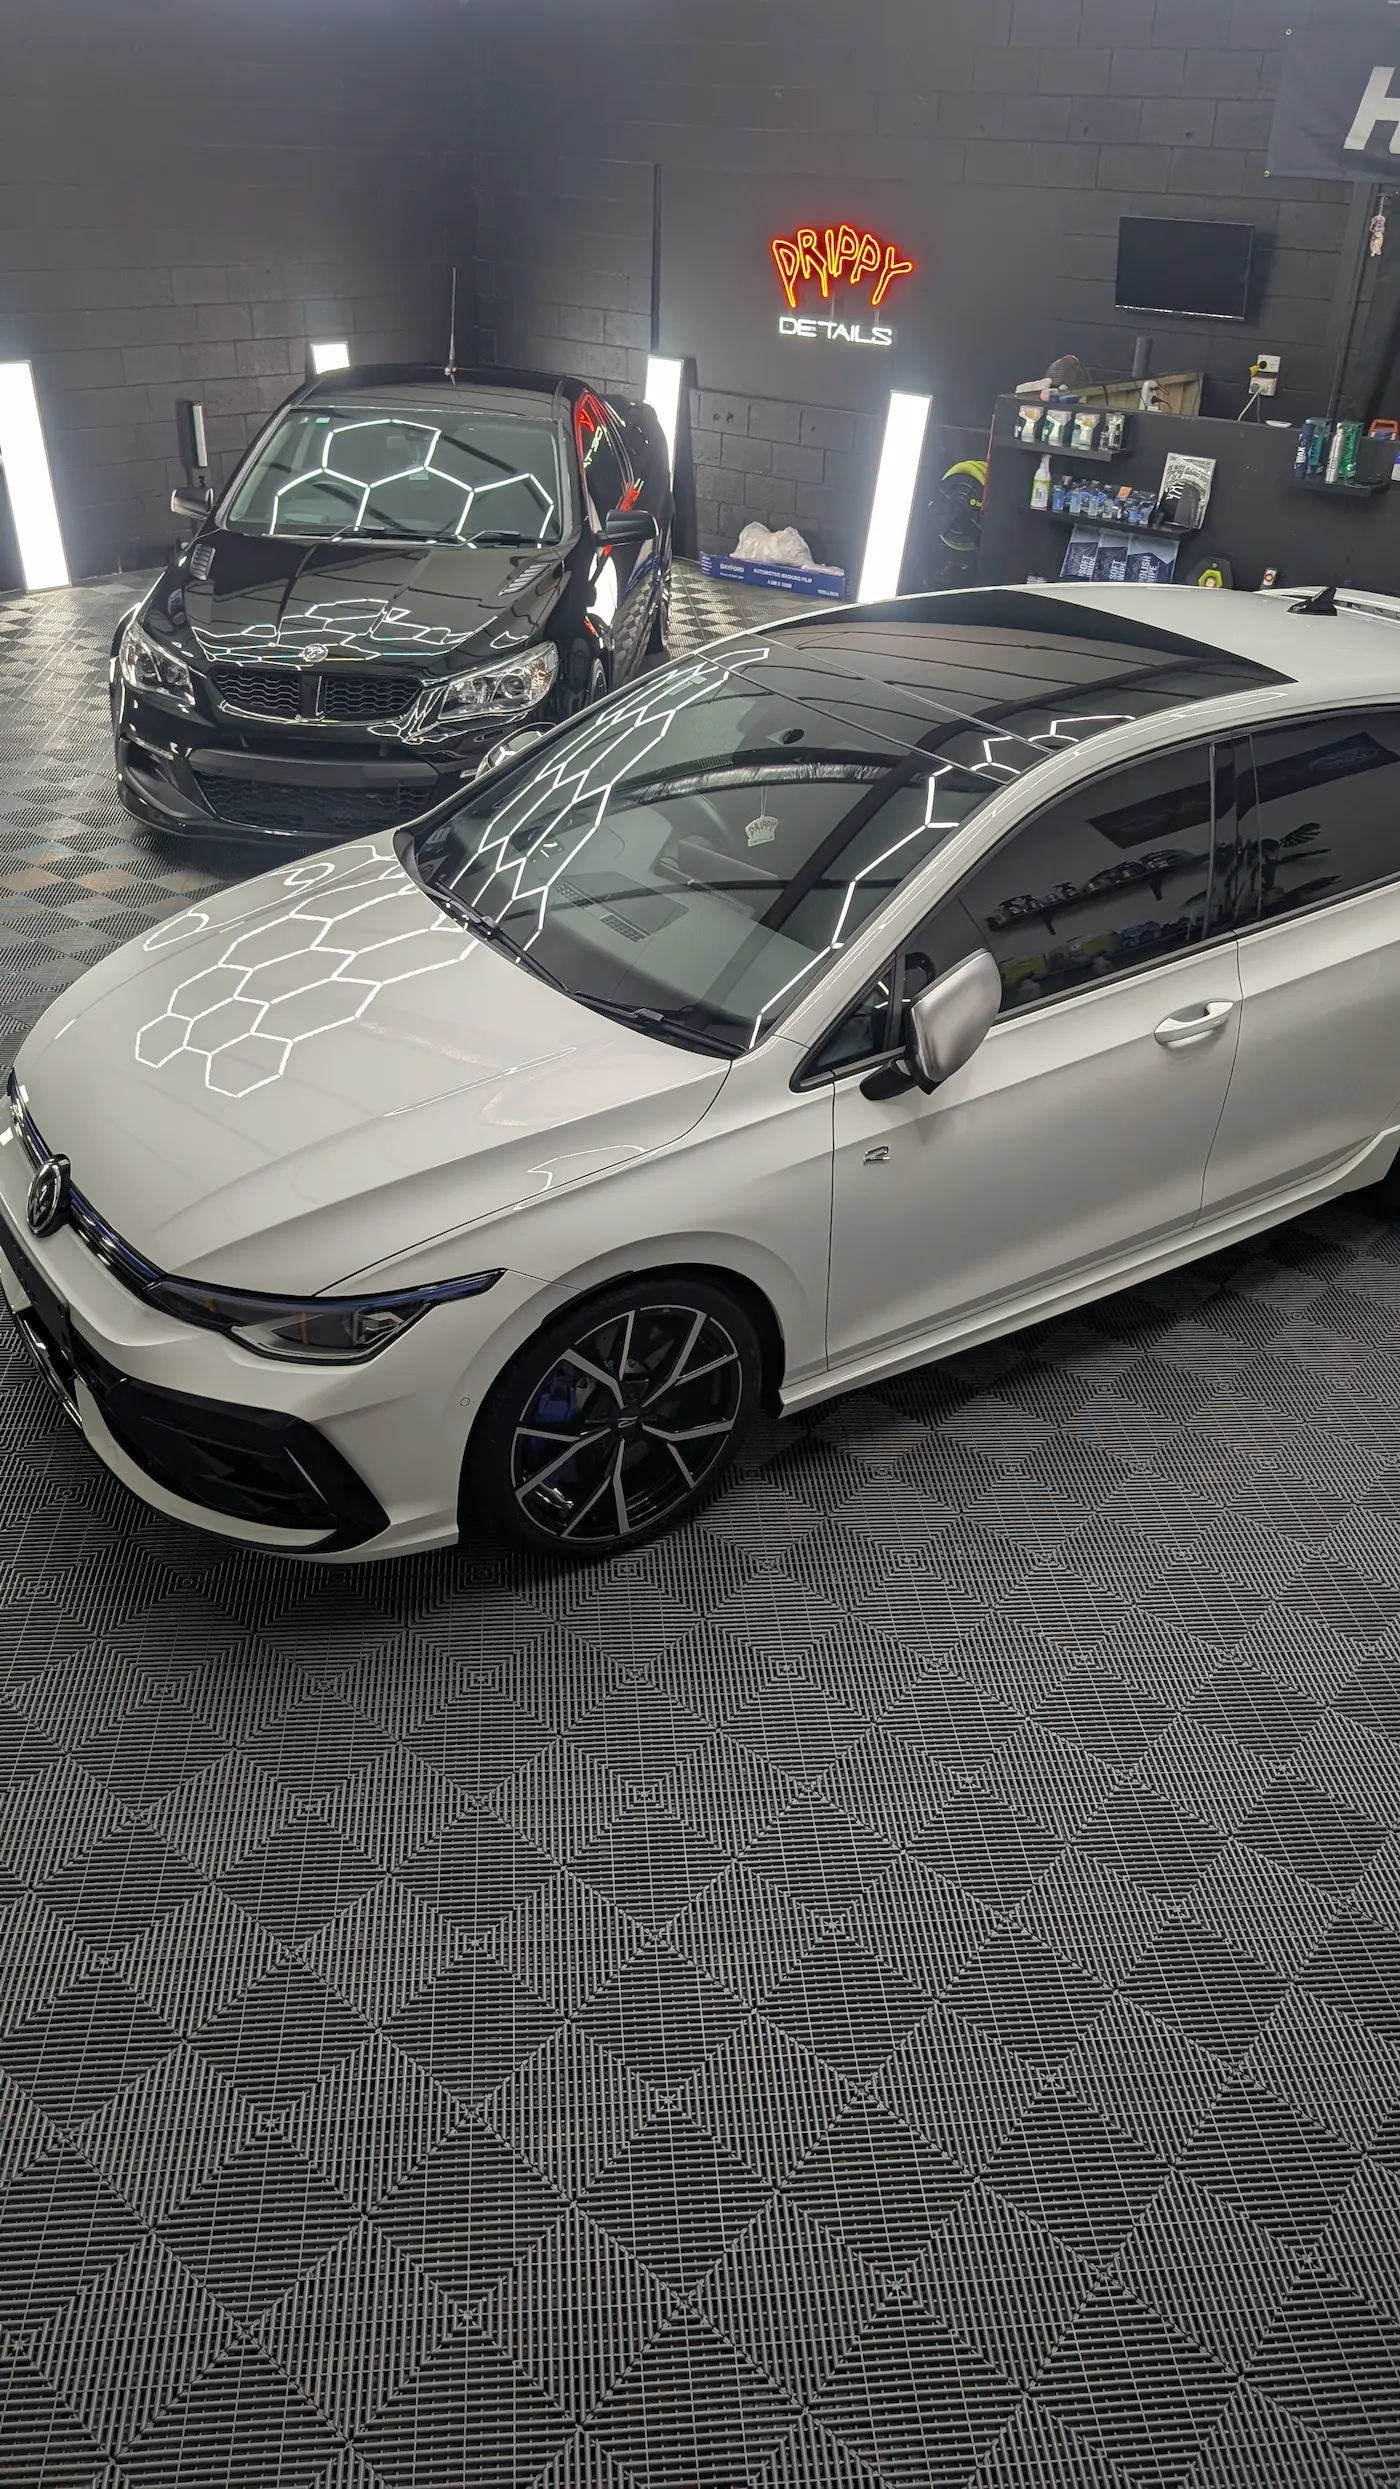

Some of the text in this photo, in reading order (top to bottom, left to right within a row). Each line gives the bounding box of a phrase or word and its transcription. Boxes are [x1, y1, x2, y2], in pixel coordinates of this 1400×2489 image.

[772, 224, 913, 309] DRIPPY
[779, 316, 893, 346] DETAILS
[1295, 446, 1306, 463] WAX
[753, 568, 781, 578] AUTOMOTIVE
[781, 573, 801, 582] MASKING
[1109, 560, 1120, 580] SOFT
